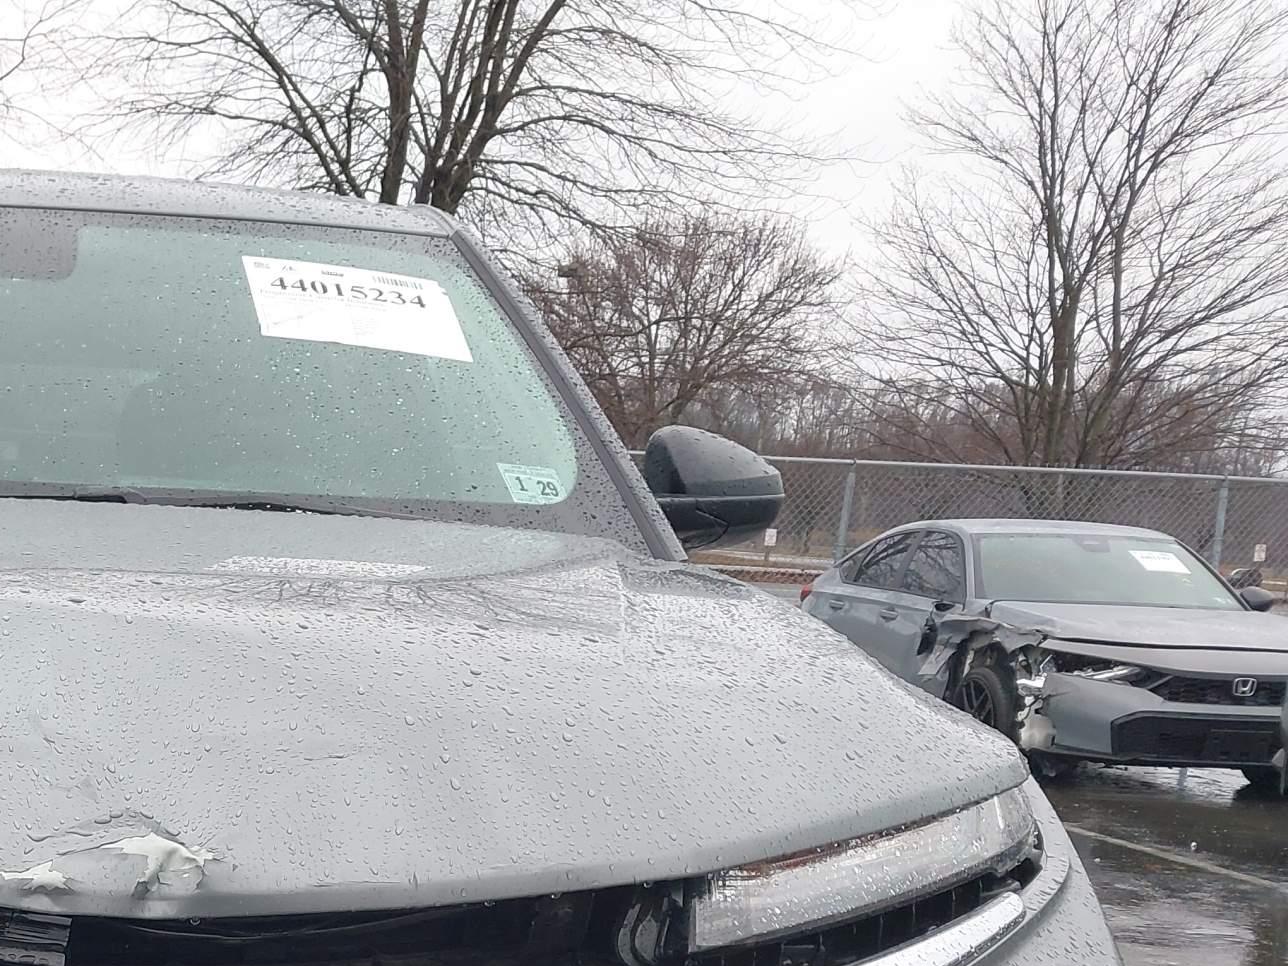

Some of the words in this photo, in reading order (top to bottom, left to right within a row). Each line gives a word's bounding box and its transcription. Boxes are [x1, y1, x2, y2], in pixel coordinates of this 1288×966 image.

[269, 275, 427, 309] 44015234
[515, 476, 529, 492] 1
[536, 480, 559, 497] 29
